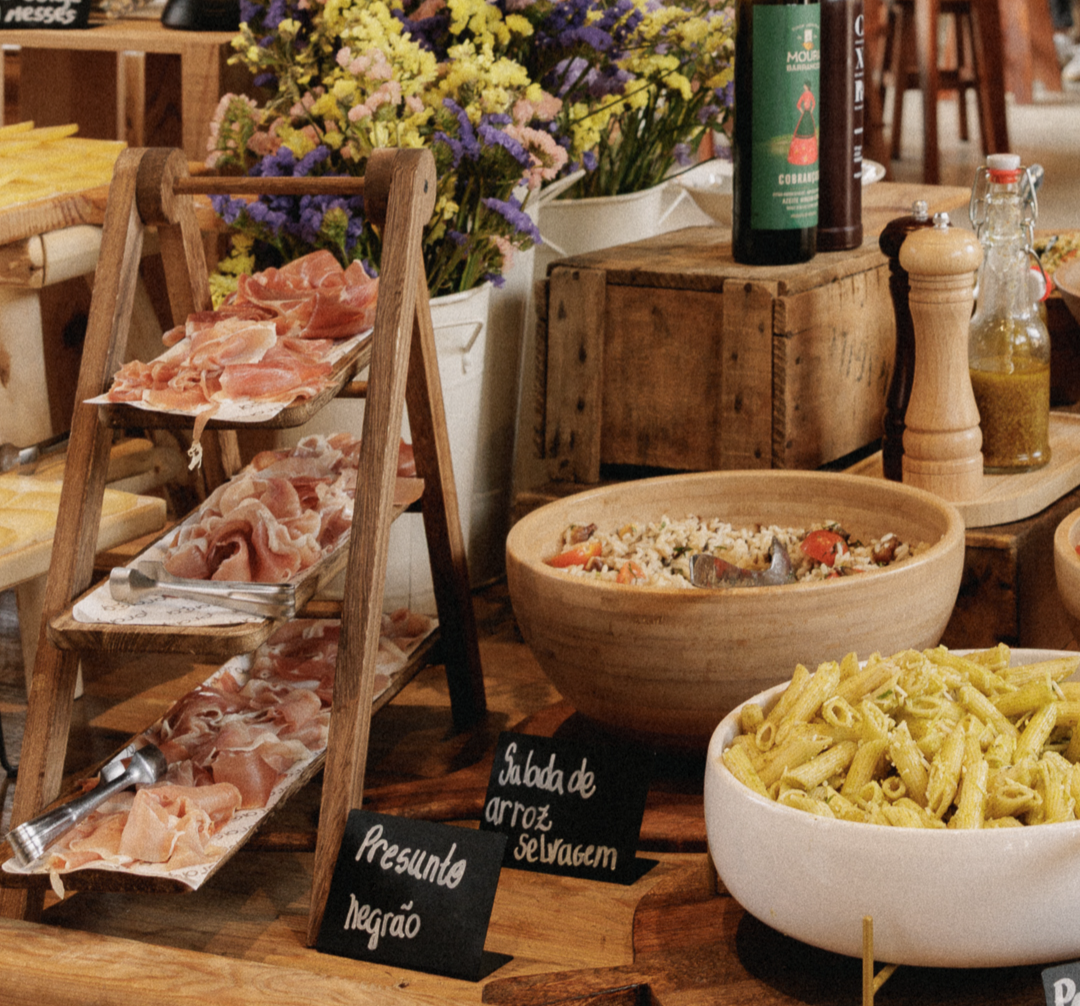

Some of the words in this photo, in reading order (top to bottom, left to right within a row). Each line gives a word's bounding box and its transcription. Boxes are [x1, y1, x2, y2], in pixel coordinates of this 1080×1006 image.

[498, 742, 564, 795] Salada
[568, 757, 596, 799] de
[485, 796, 552, 832] arroz
[355, 824, 467, 889] Presunto
